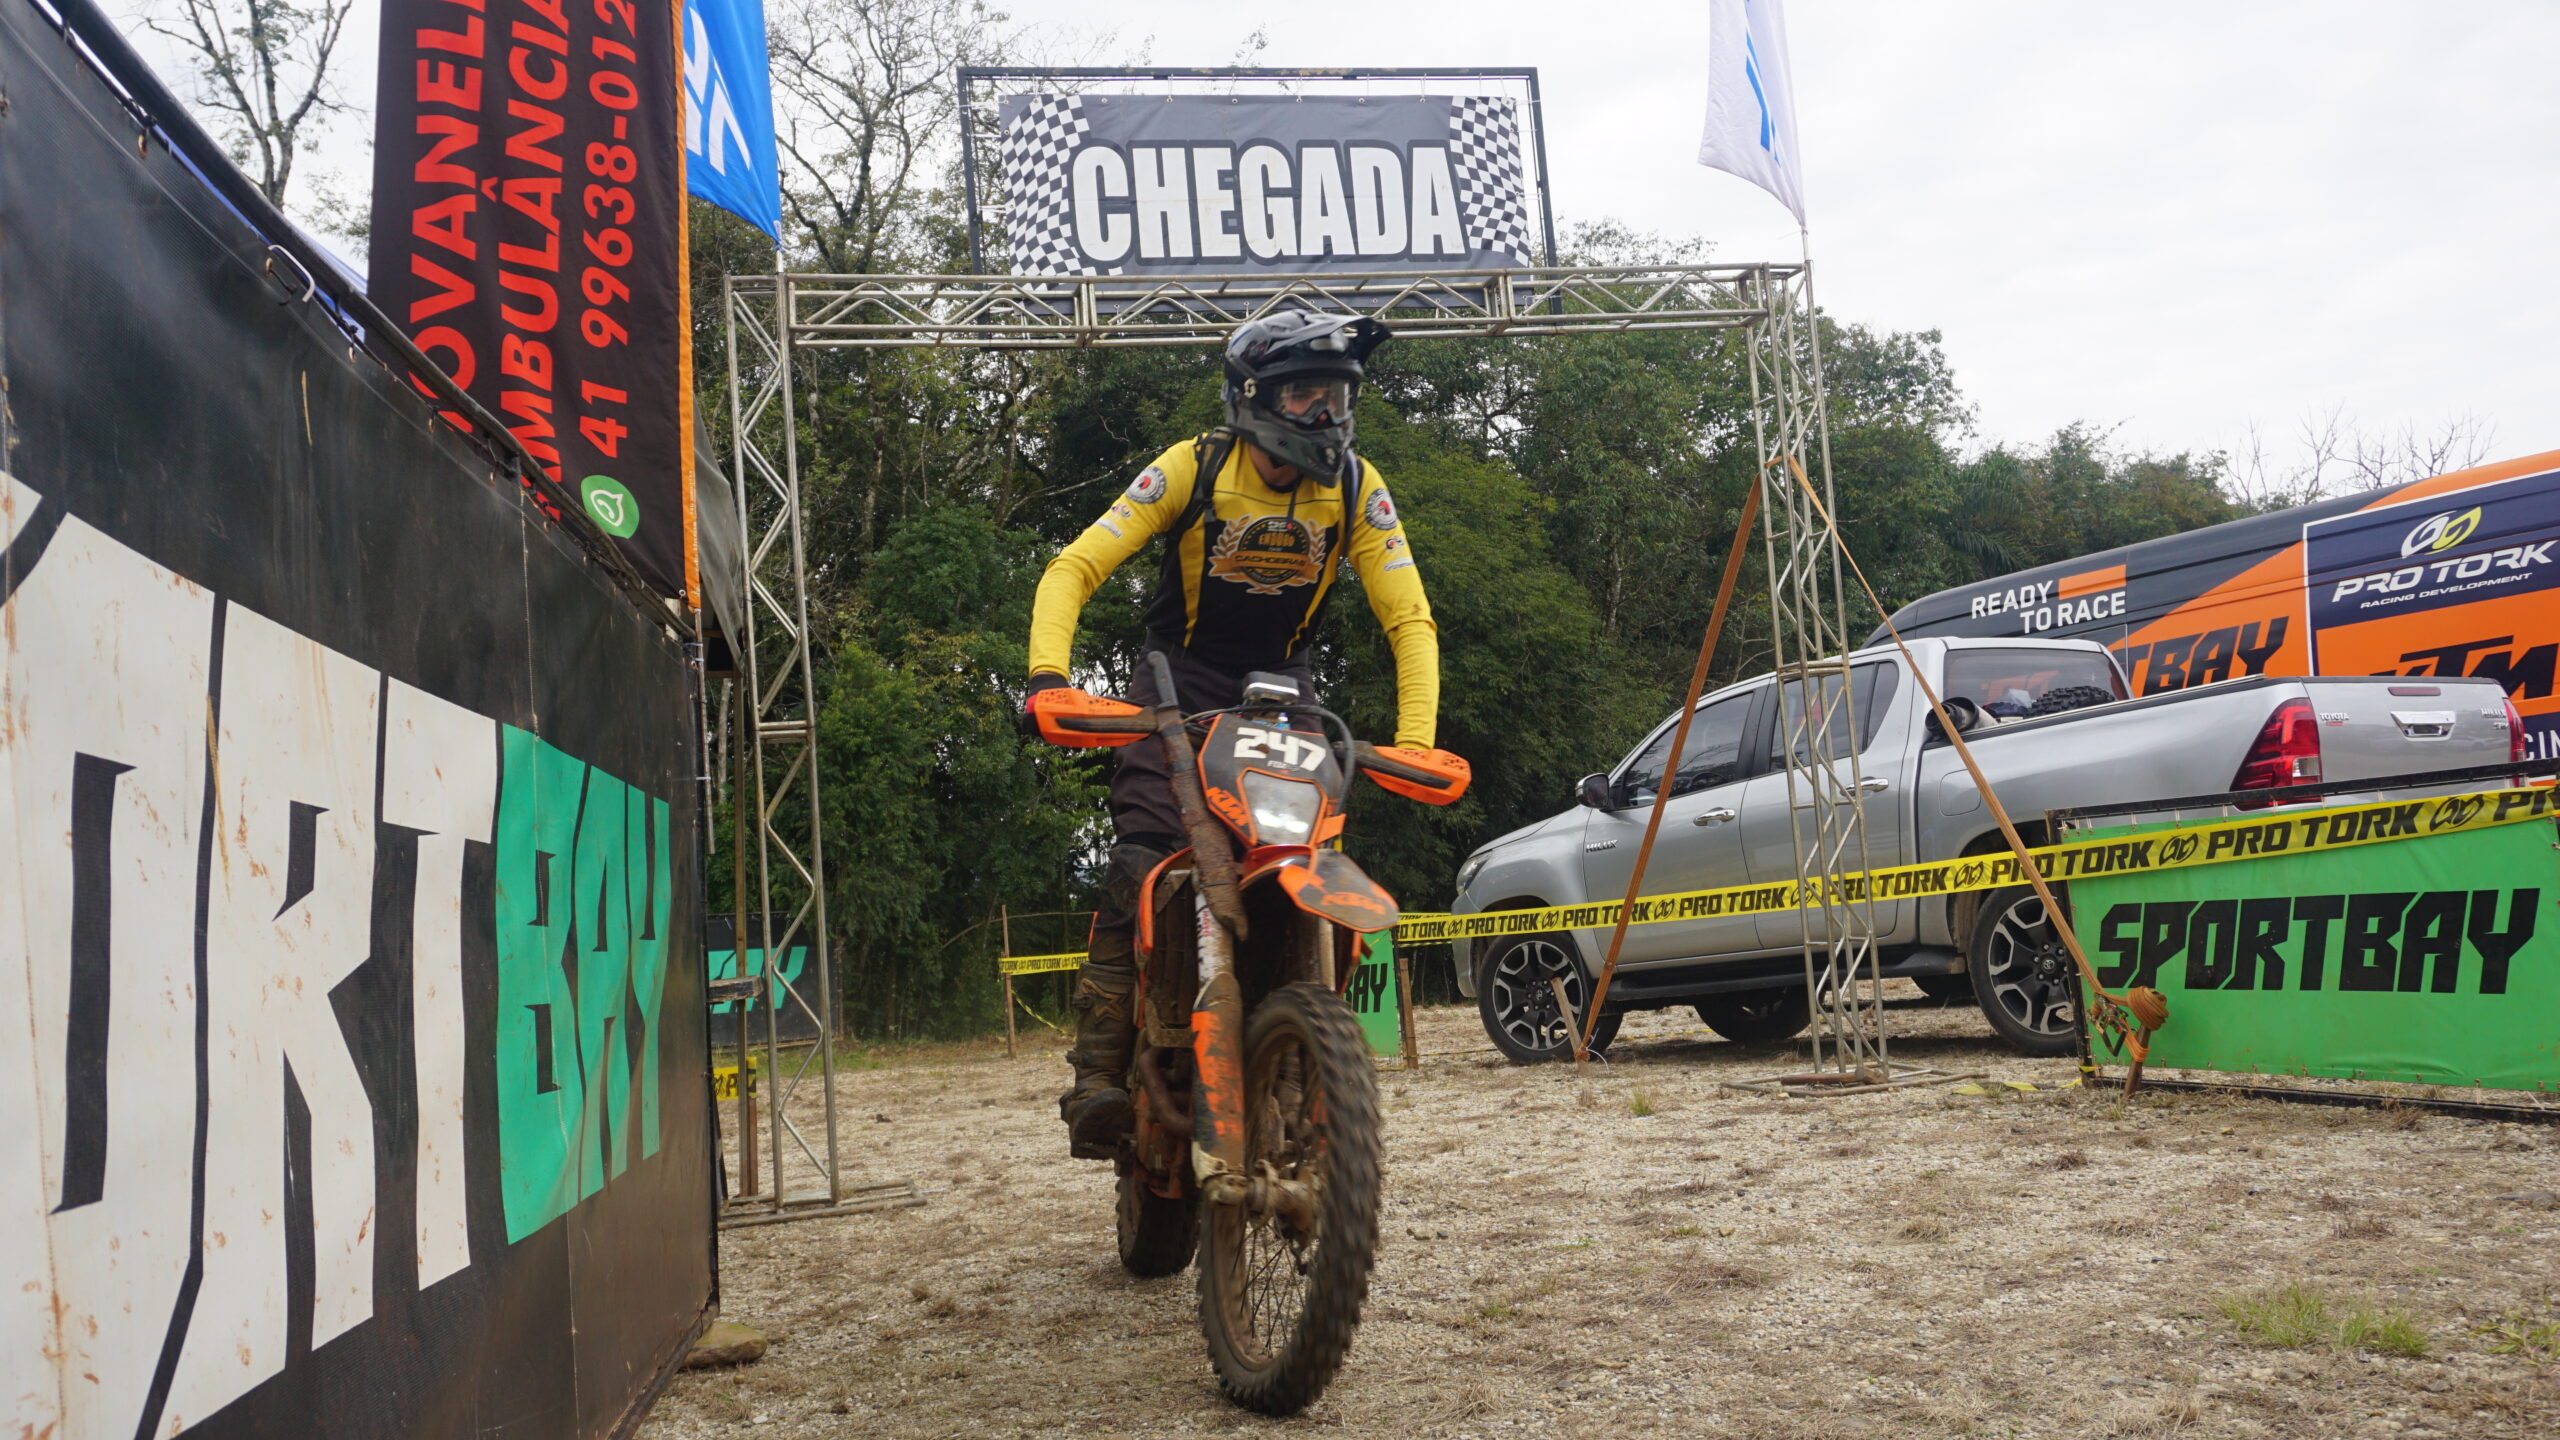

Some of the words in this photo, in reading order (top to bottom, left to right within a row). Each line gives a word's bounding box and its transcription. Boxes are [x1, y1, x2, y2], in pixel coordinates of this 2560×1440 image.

[407, 0, 486, 433] OVANEL
[1072, 144, 1467, 263] CHEGADA
[579, 379, 628, 458] 41
[1971, 579, 2053, 619] READY
[2331, 565, 2424, 603] PRO
[2430, 540, 2559, 583] TORK
[2360, 593, 2415, 609] RACING
[2418, 572, 2533, 599] DEVELOPMENT
[2020, 606, 2052, 634] TO
[2057, 591, 2126, 627] RACE
[1233, 727, 1326, 772] 247
[1411, 920, 1446, 939] TORK
[1465, 917, 1494, 935] PRO
[1500, 911, 1541, 933] TORK
[1562, 908, 1598, 928] PRO
[1678, 893, 1722, 918] PRO
[1727, 886, 1788, 913] TORK
[1879, 867, 1950, 898] TORK
[2062, 840, 2154, 876] TORK
[2206, 821, 2292, 860] PRO
[2300, 802, 2424, 845] TORK
[0, 468, 672, 1440] ORTBAY
[2097, 888, 2541, 995] SPORTBAY
[1343, 963, 1388, 1014] AY
